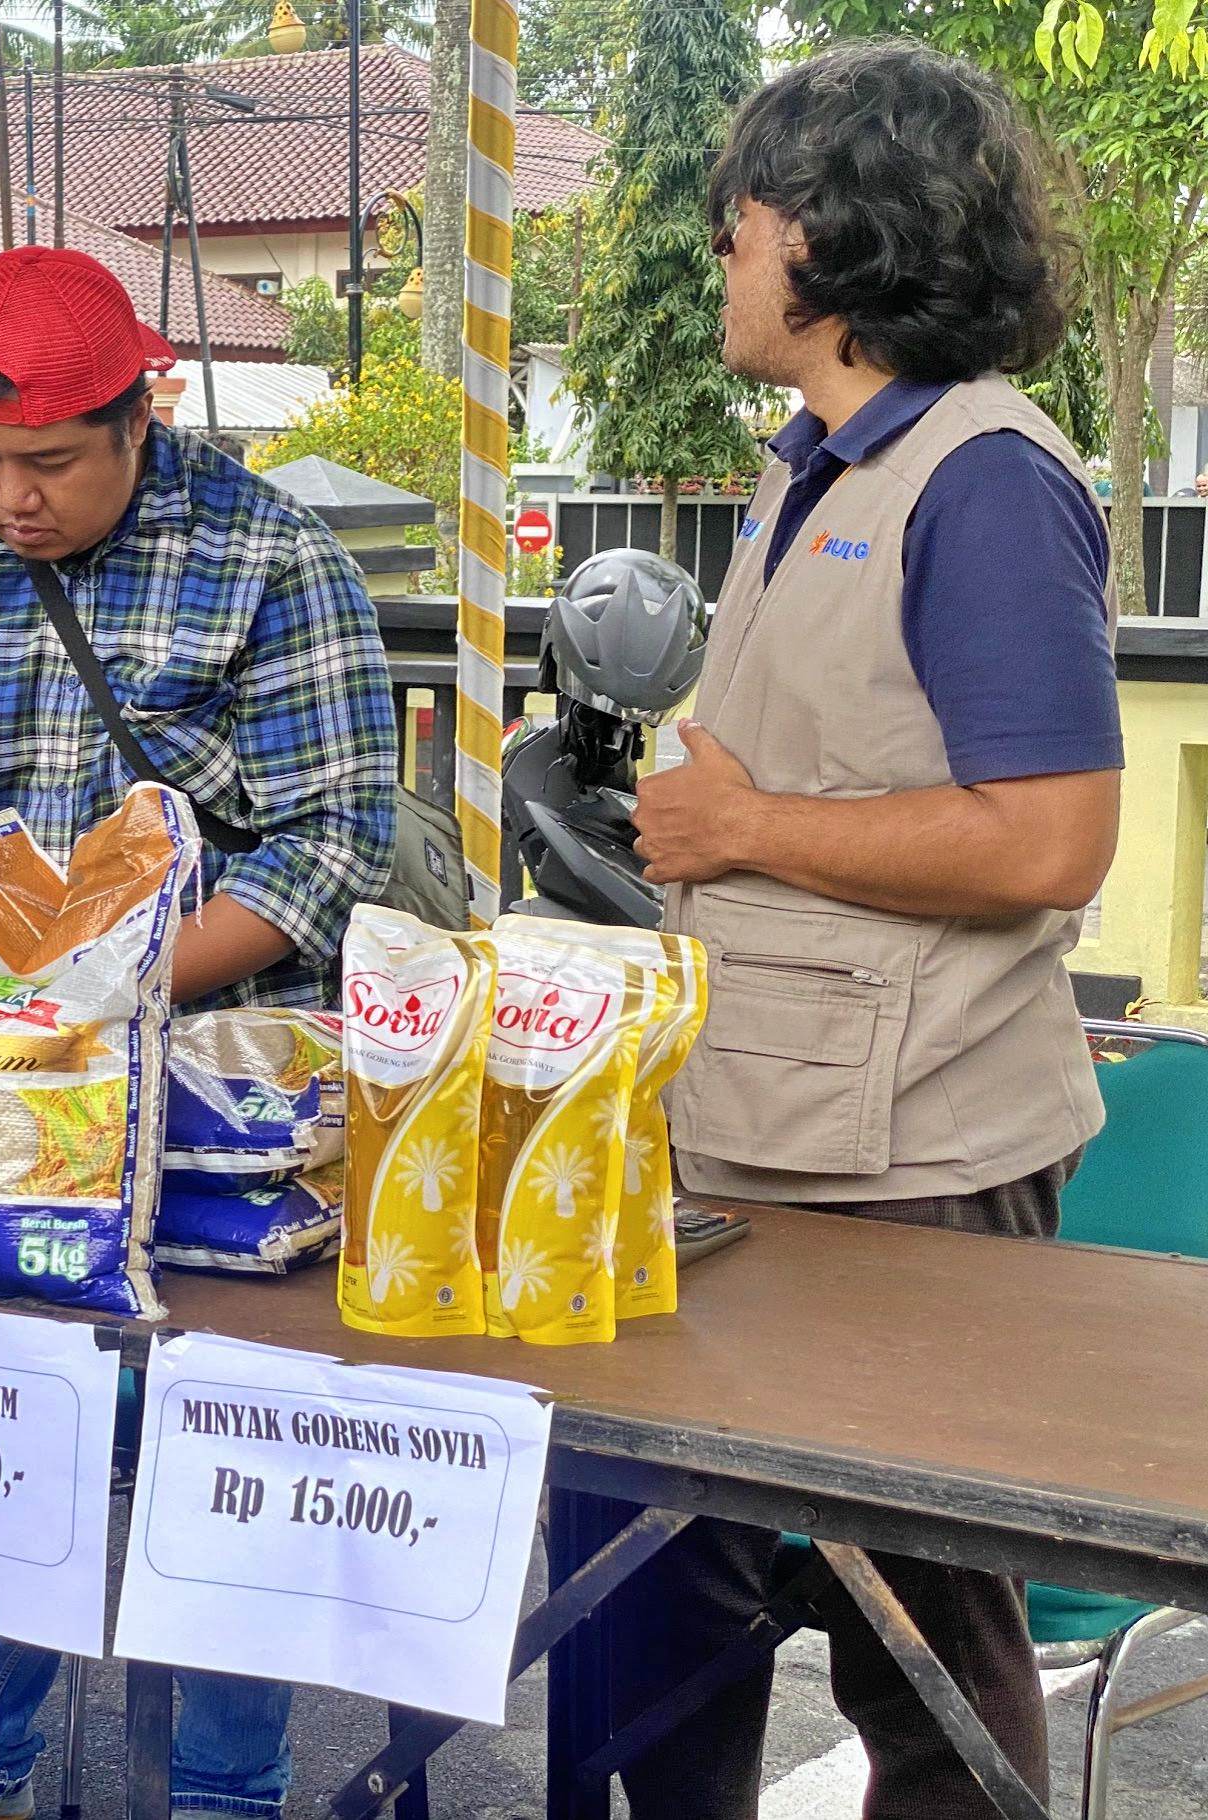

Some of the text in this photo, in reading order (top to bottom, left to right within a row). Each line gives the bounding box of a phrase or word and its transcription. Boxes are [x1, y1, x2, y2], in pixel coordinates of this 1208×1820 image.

[346, 980, 445, 1037] Sovia
[492, 986, 580, 1044] ovia
[528, 1057, 555, 1073] SAWIT
[21, 1216, 51, 1230] Berat
[181, 1398, 487, 1470] MINYAK GORENG SOVIA
[210, 1466, 439, 1548] Rp 15.000,-
